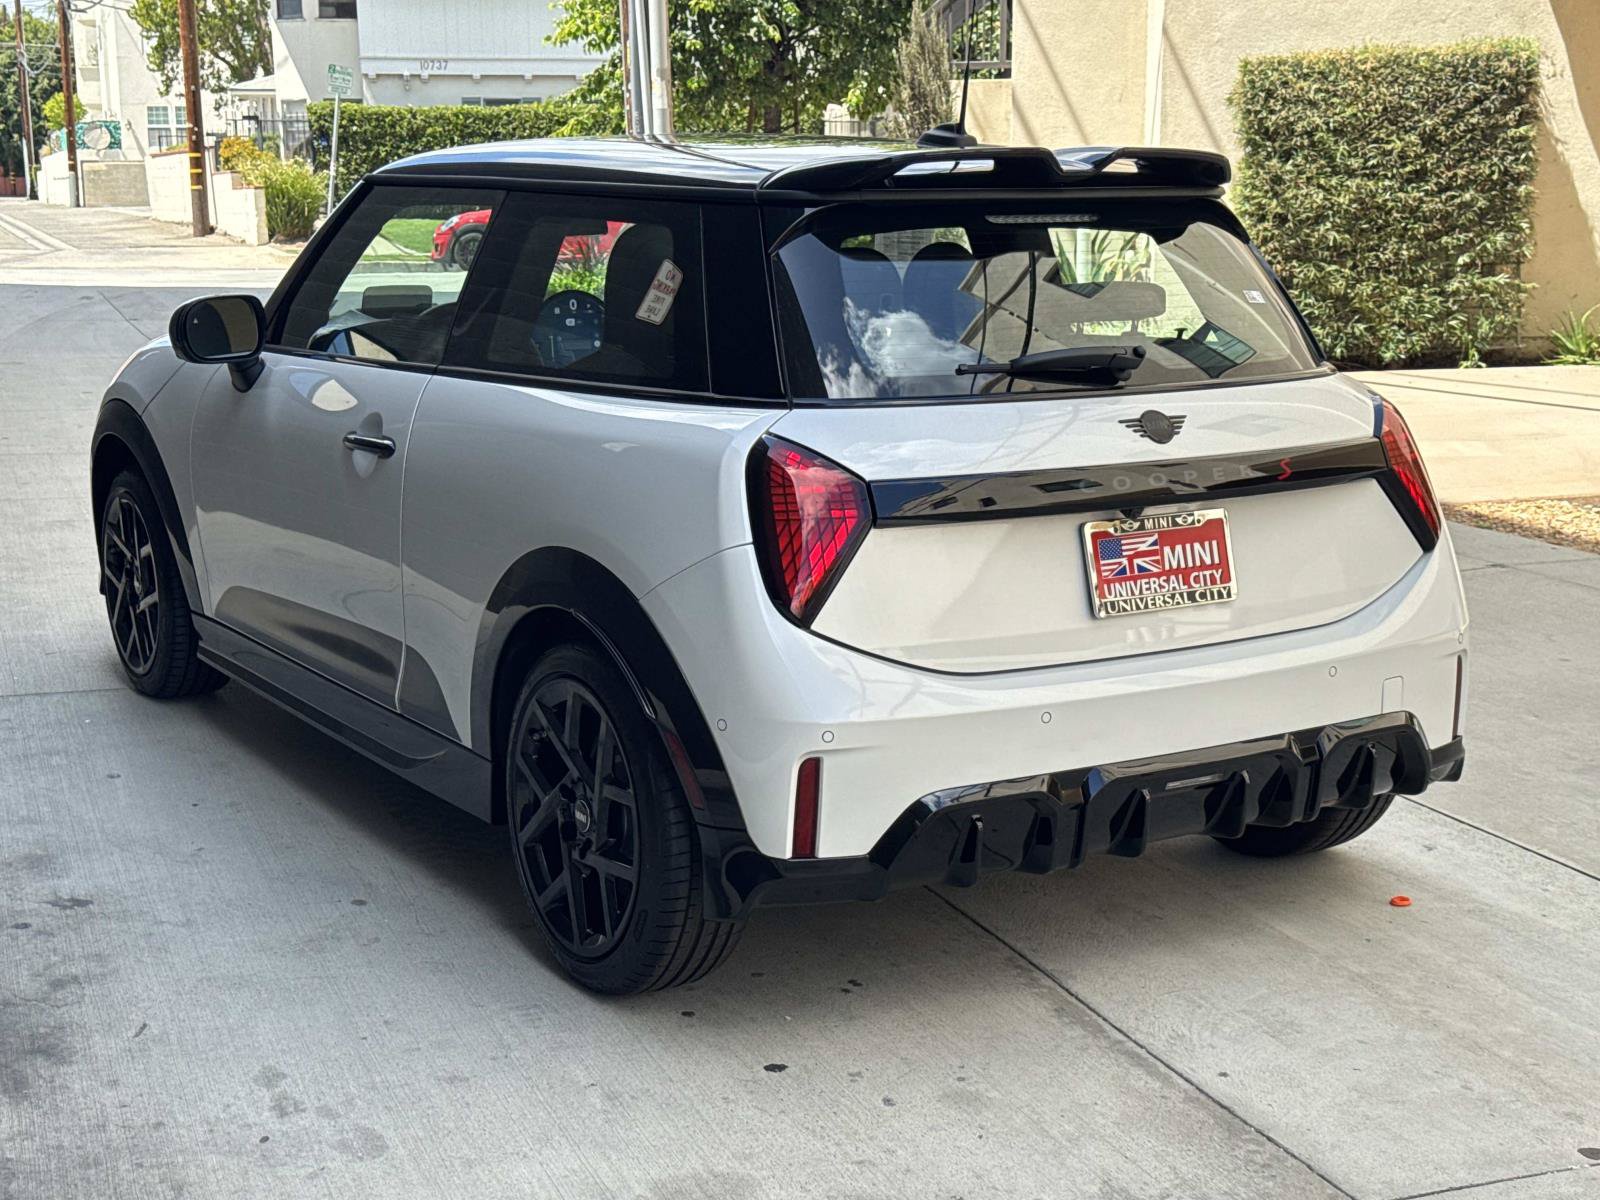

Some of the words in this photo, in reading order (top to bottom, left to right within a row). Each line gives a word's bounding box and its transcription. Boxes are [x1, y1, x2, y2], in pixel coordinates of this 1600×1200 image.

[420, 60, 448, 70] 10737
[1079, 464, 1252, 493] COOPER
[1278, 458, 1292, 480] S
[1144, 516, 1172, 530] MINI
[1163, 540, 1220, 571] MINI
[1103, 573, 1187, 598] UNIVERSAL
[1189, 568, 1223, 588] CITY
[1106, 591, 1192, 614] UNIVERSAL
[1195, 586, 1231, 602] CITY
